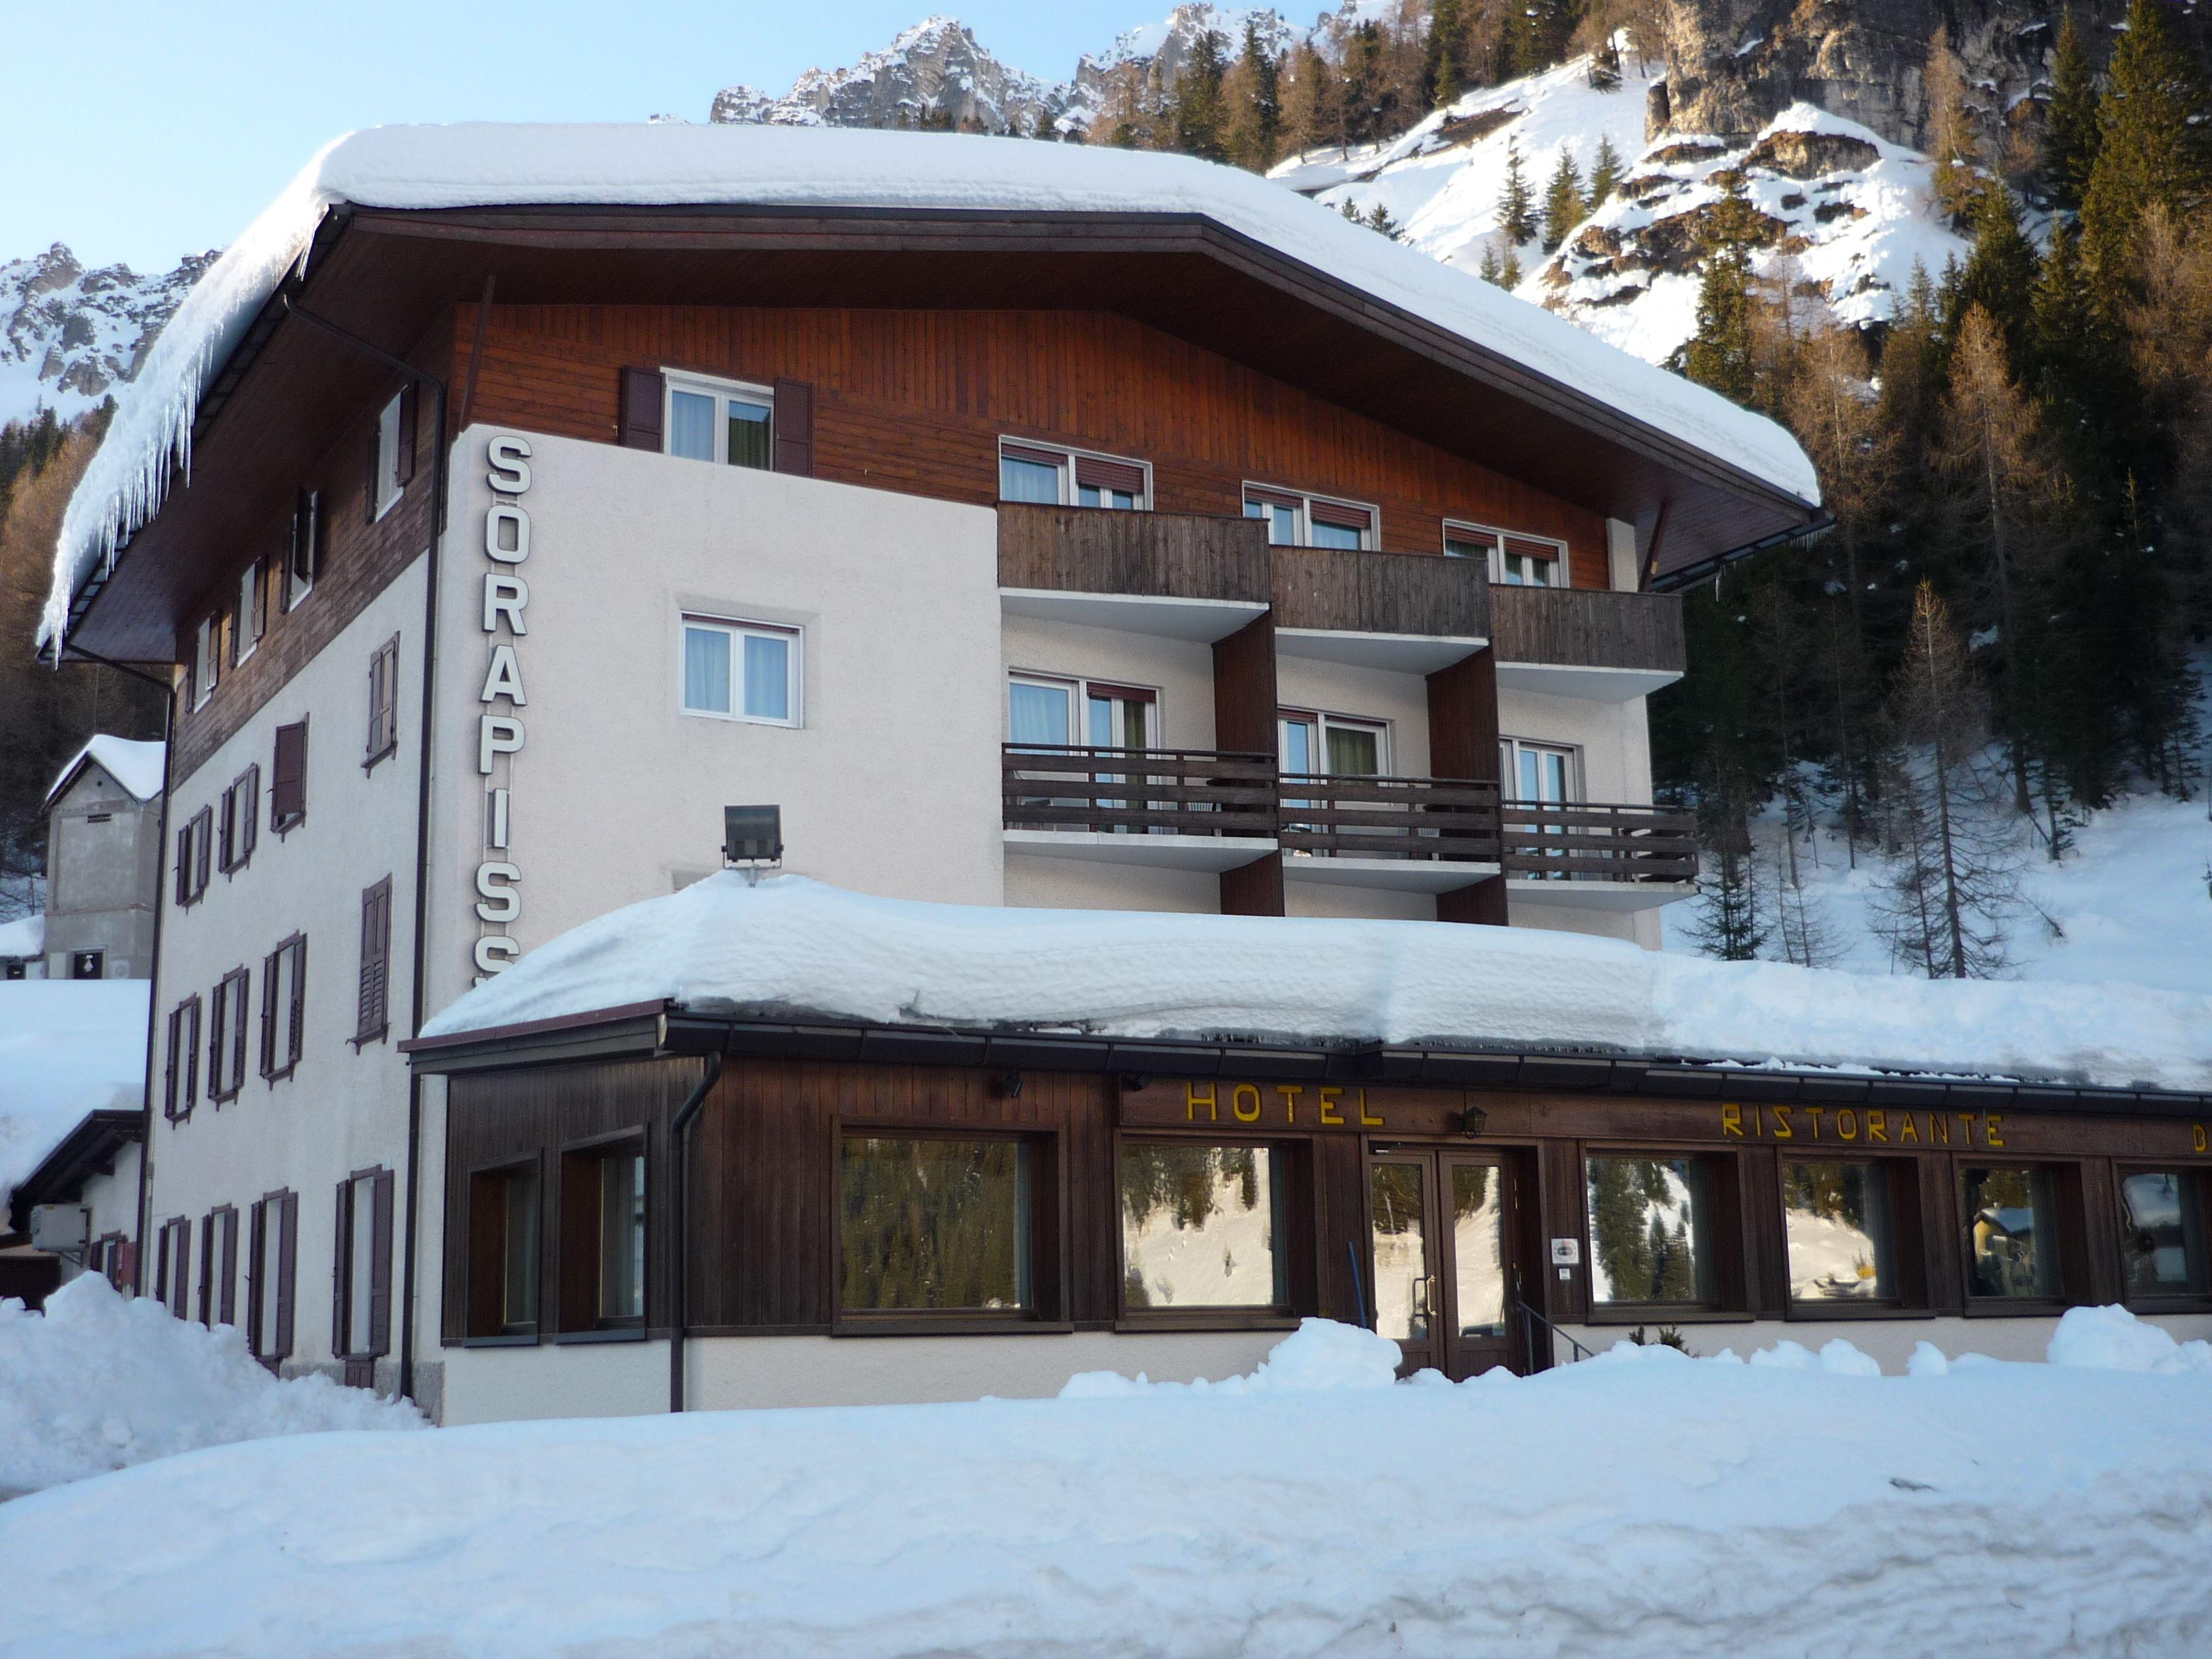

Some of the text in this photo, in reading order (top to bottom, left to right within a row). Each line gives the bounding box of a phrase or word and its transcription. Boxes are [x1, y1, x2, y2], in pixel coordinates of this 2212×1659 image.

[472, 435, 533, 989] SORAPISS
[1186, 1082, 1384, 1125] HOTEL
[1721, 1103, 2004, 1147] RISTORANTE
